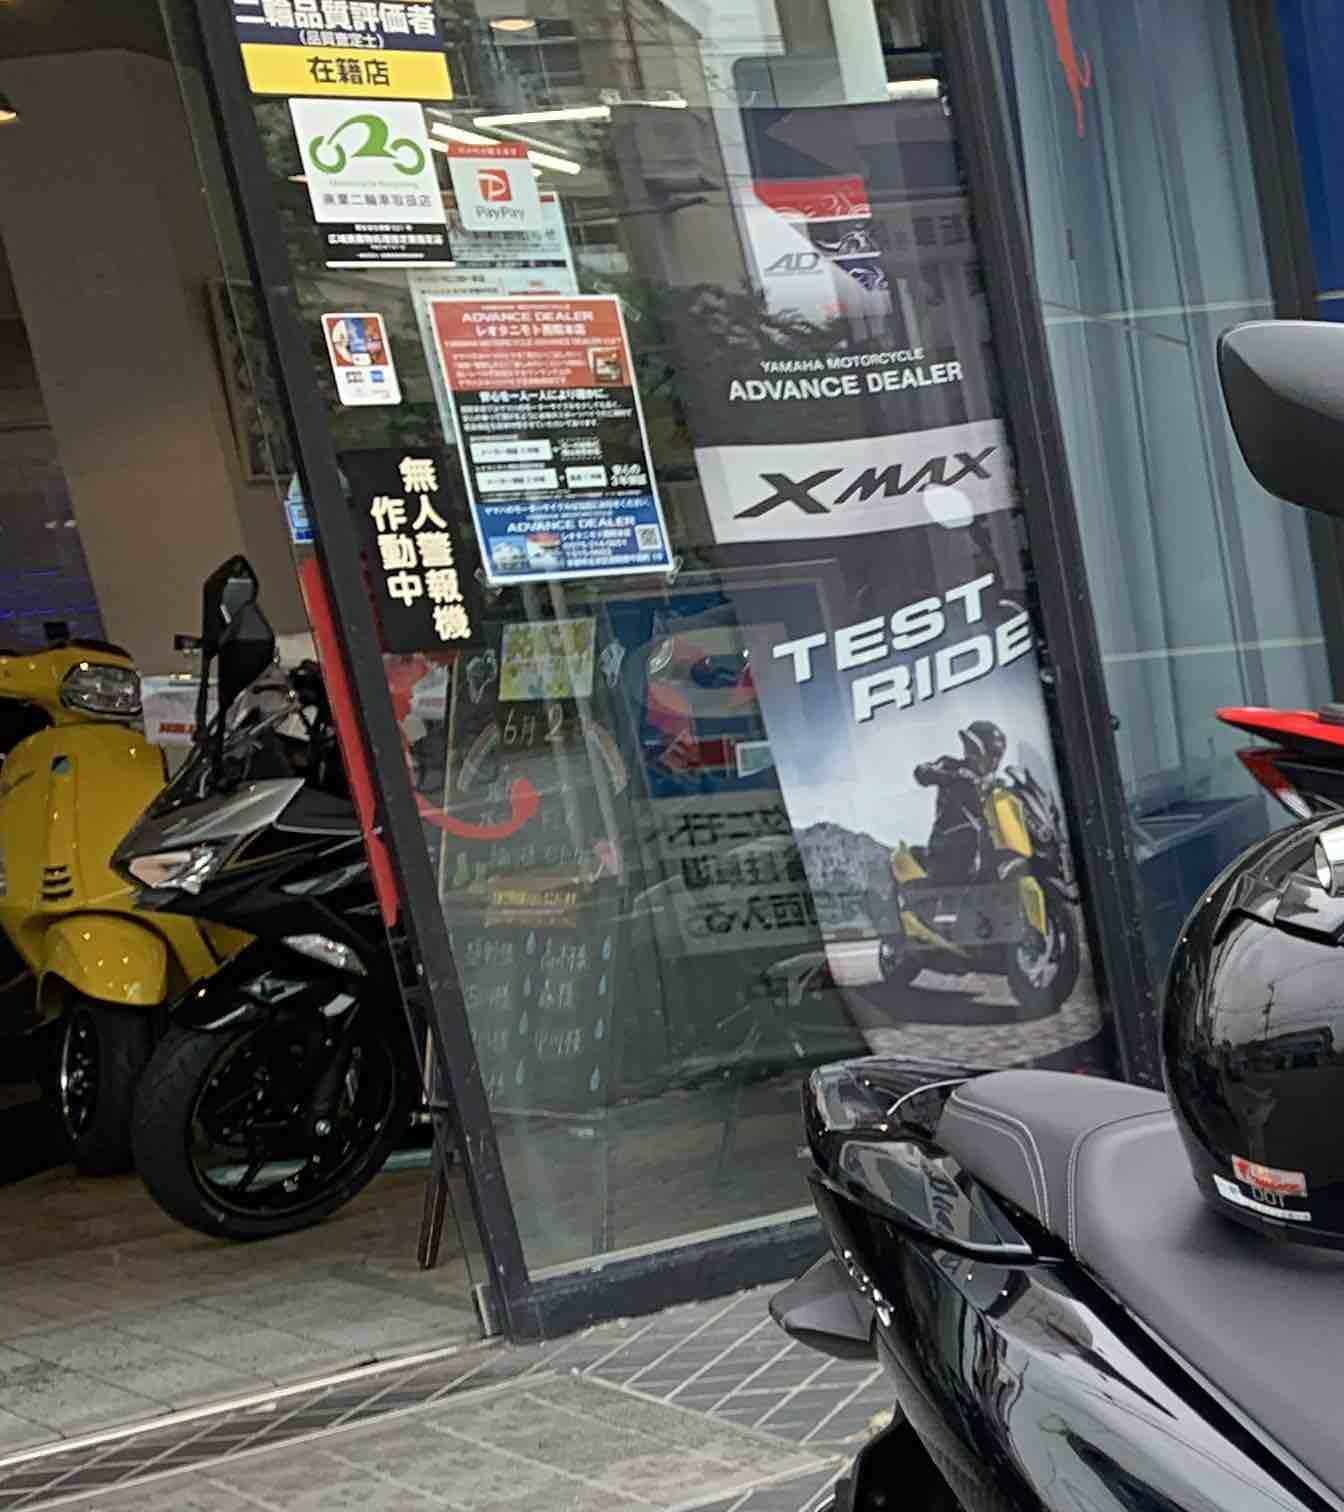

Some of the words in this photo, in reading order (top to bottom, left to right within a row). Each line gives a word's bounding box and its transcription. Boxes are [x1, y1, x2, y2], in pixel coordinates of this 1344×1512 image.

[307, 56, 390, 86] 在籍店
[475, 206, 524, 218] PayPay
[462, 311, 532, 323] ADVANCE
[535, 310, 593, 321] DEALER
[760, 357, 823, 374] YAMAHA
[826, 347, 925, 370] MOTORCYCLE
[729, 373, 860, 401] ADVANCE
[867, 361, 963, 391] DEALER
[507, 518, 576, 532] ADVANCE
[579, 515, 636, 528] DEALER
[370, 496, 425, 607] 作動中
[399, 456, 471, 641] 無人警報機
[773, 573, 994, 682] TEST
[852, 611, 1032, 723] RIDE
